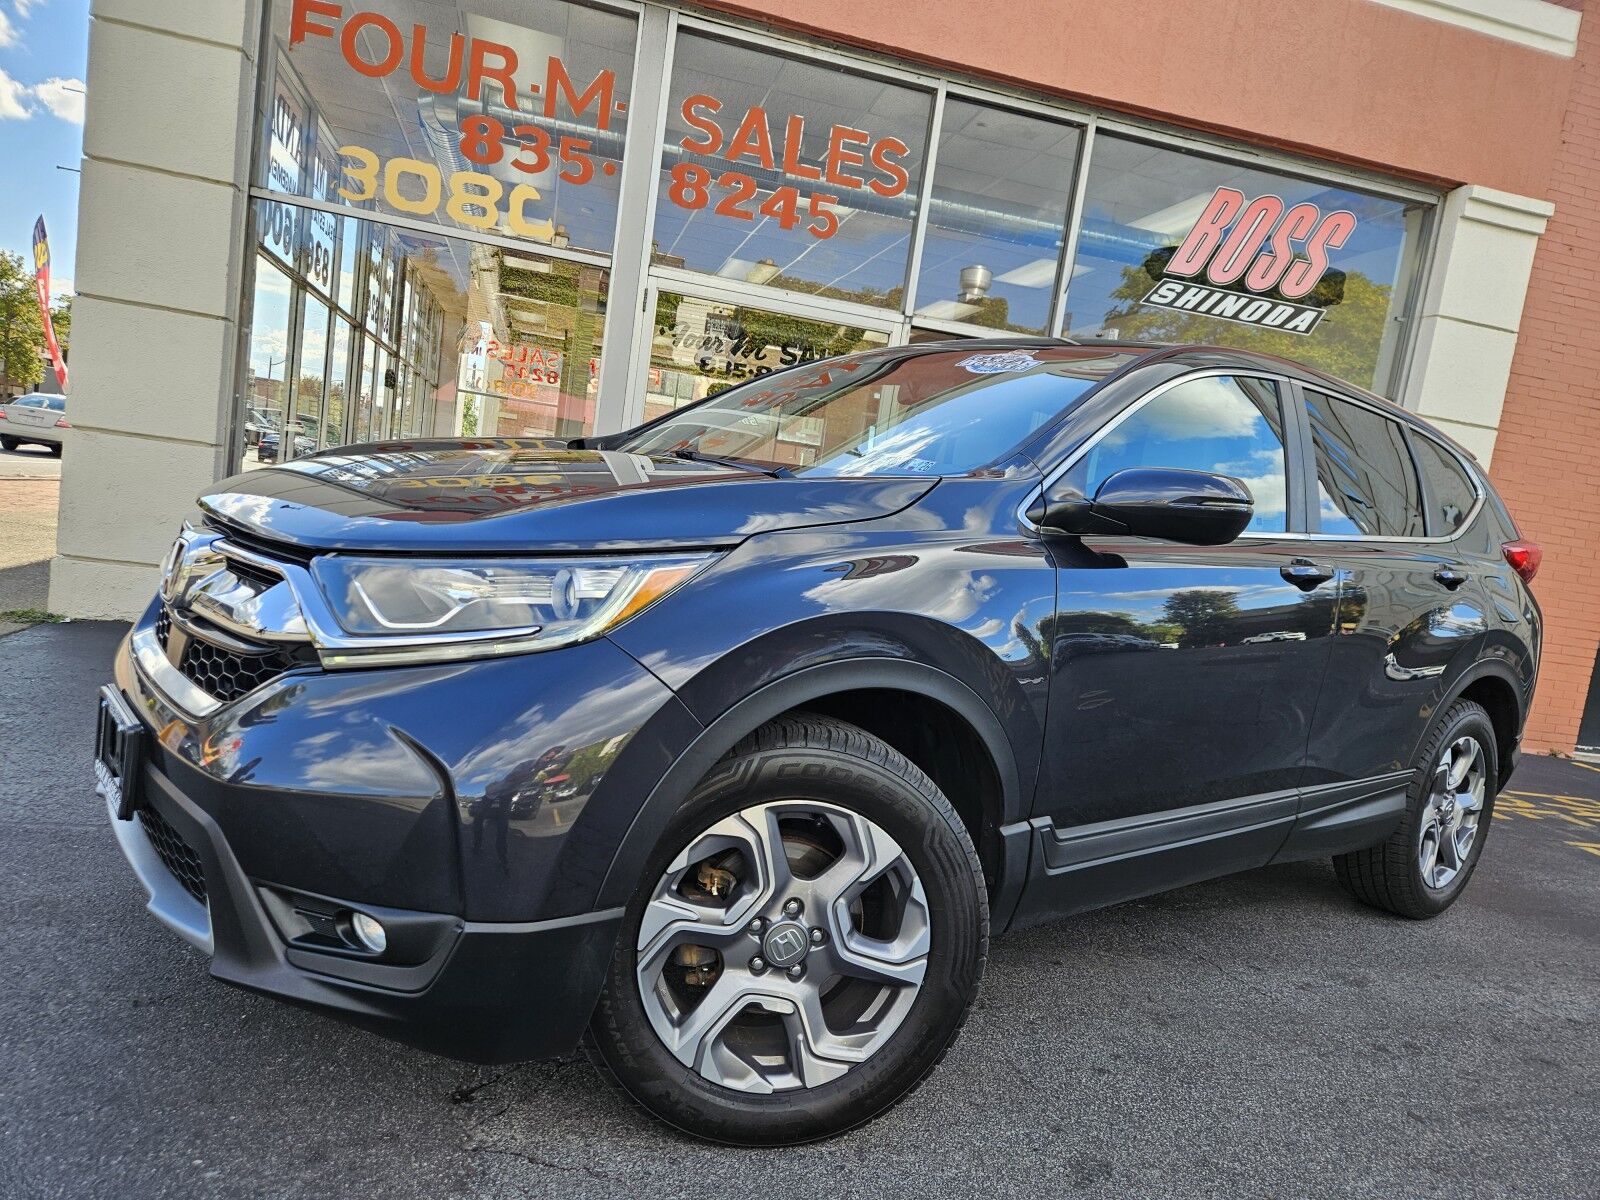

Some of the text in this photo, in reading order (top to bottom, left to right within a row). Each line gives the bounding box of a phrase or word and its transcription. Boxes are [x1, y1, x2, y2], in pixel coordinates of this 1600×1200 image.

[680, 94, 910, 198] SALES
[668, 162, 840, 240] 8245
[1163, 185, 1358, 299] BOSS
[1150, 282, 1318, 332] SHINODA
